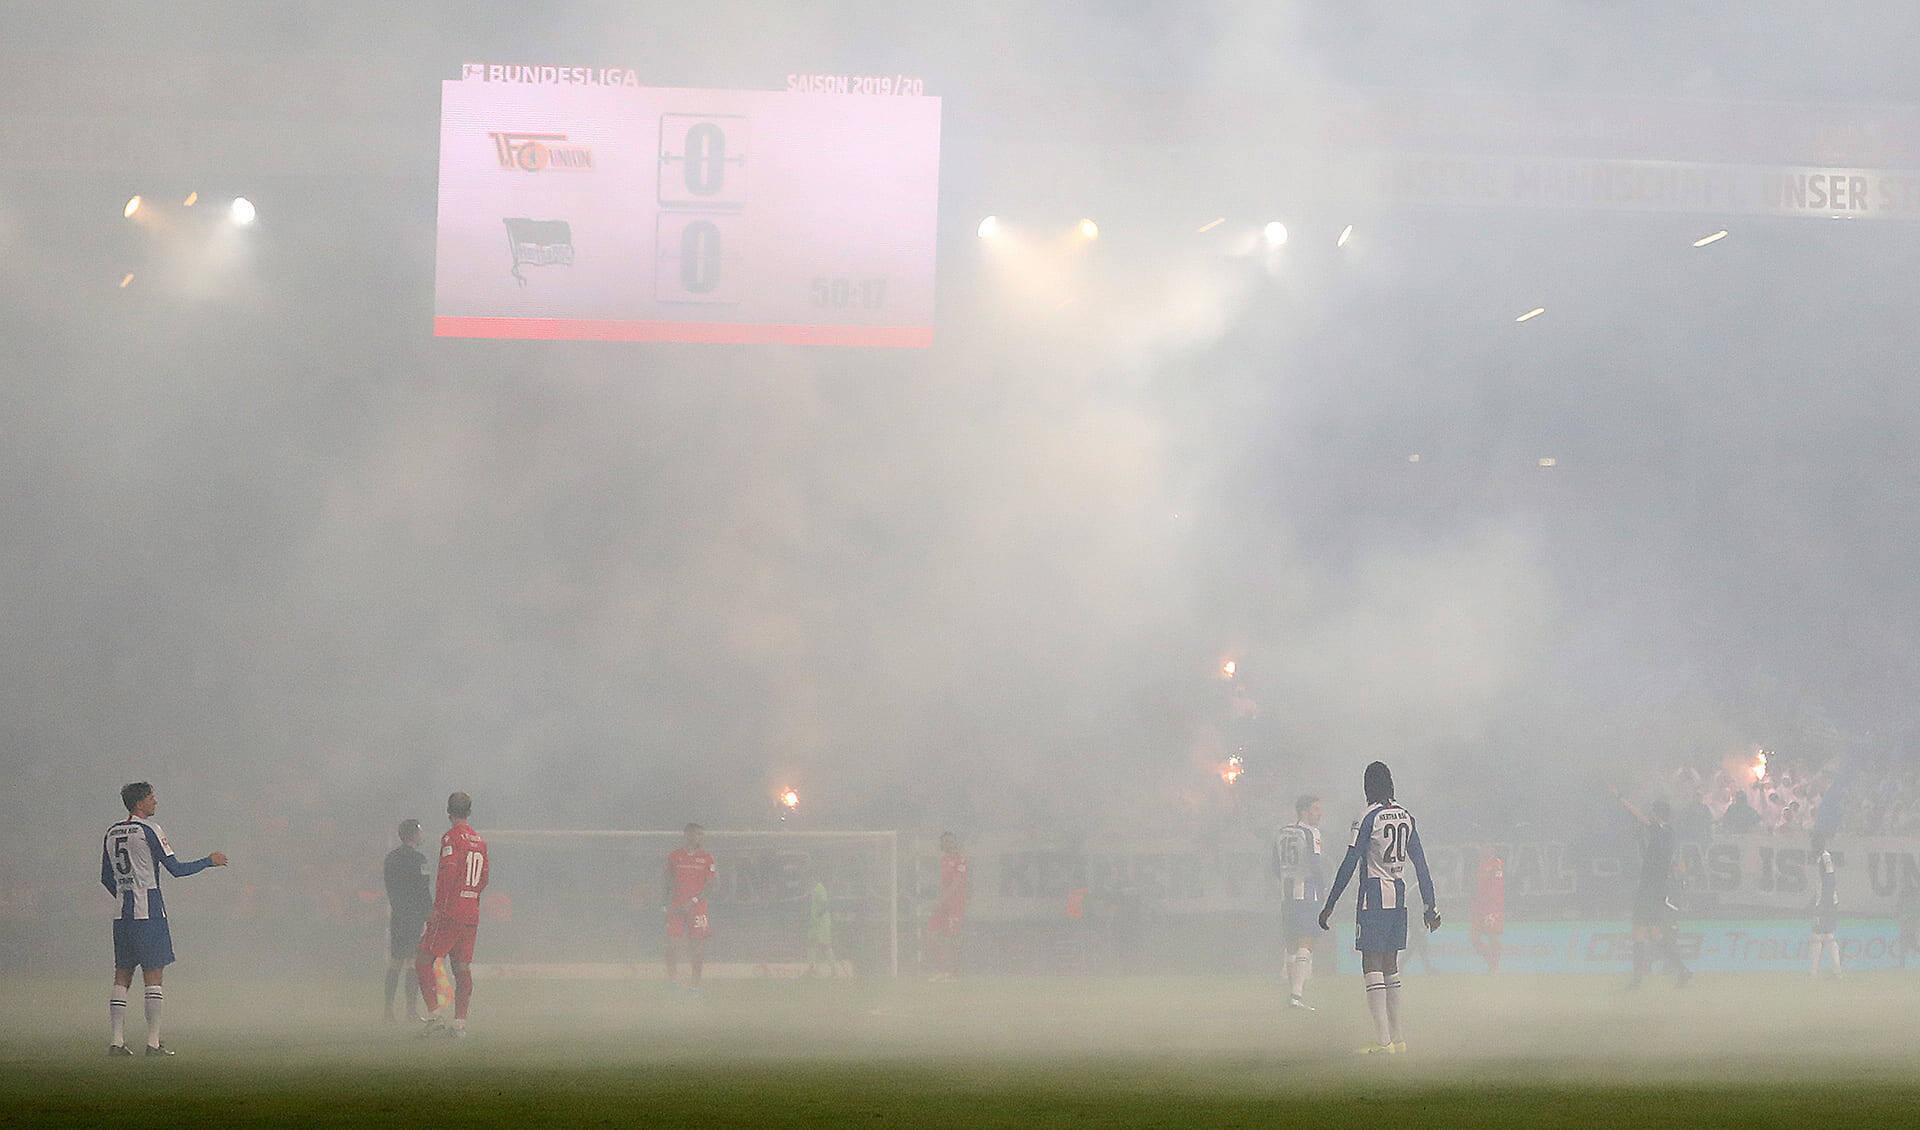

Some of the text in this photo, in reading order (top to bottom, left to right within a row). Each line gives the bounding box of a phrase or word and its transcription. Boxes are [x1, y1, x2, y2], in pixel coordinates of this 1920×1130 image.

[488, 63, 639, 88] BUNDESLIGA
[786, 73, 925, 97] SAISON 2019/20
[684, 122, 726, 196] 0
[1762, 173, 1869, 210] UNSER
[680, 219, 723, 294] 0
[115, 836, 132, 875] 5
[1382, 822, 1410, 863] 20
[465, 851, 484, 888] 10
